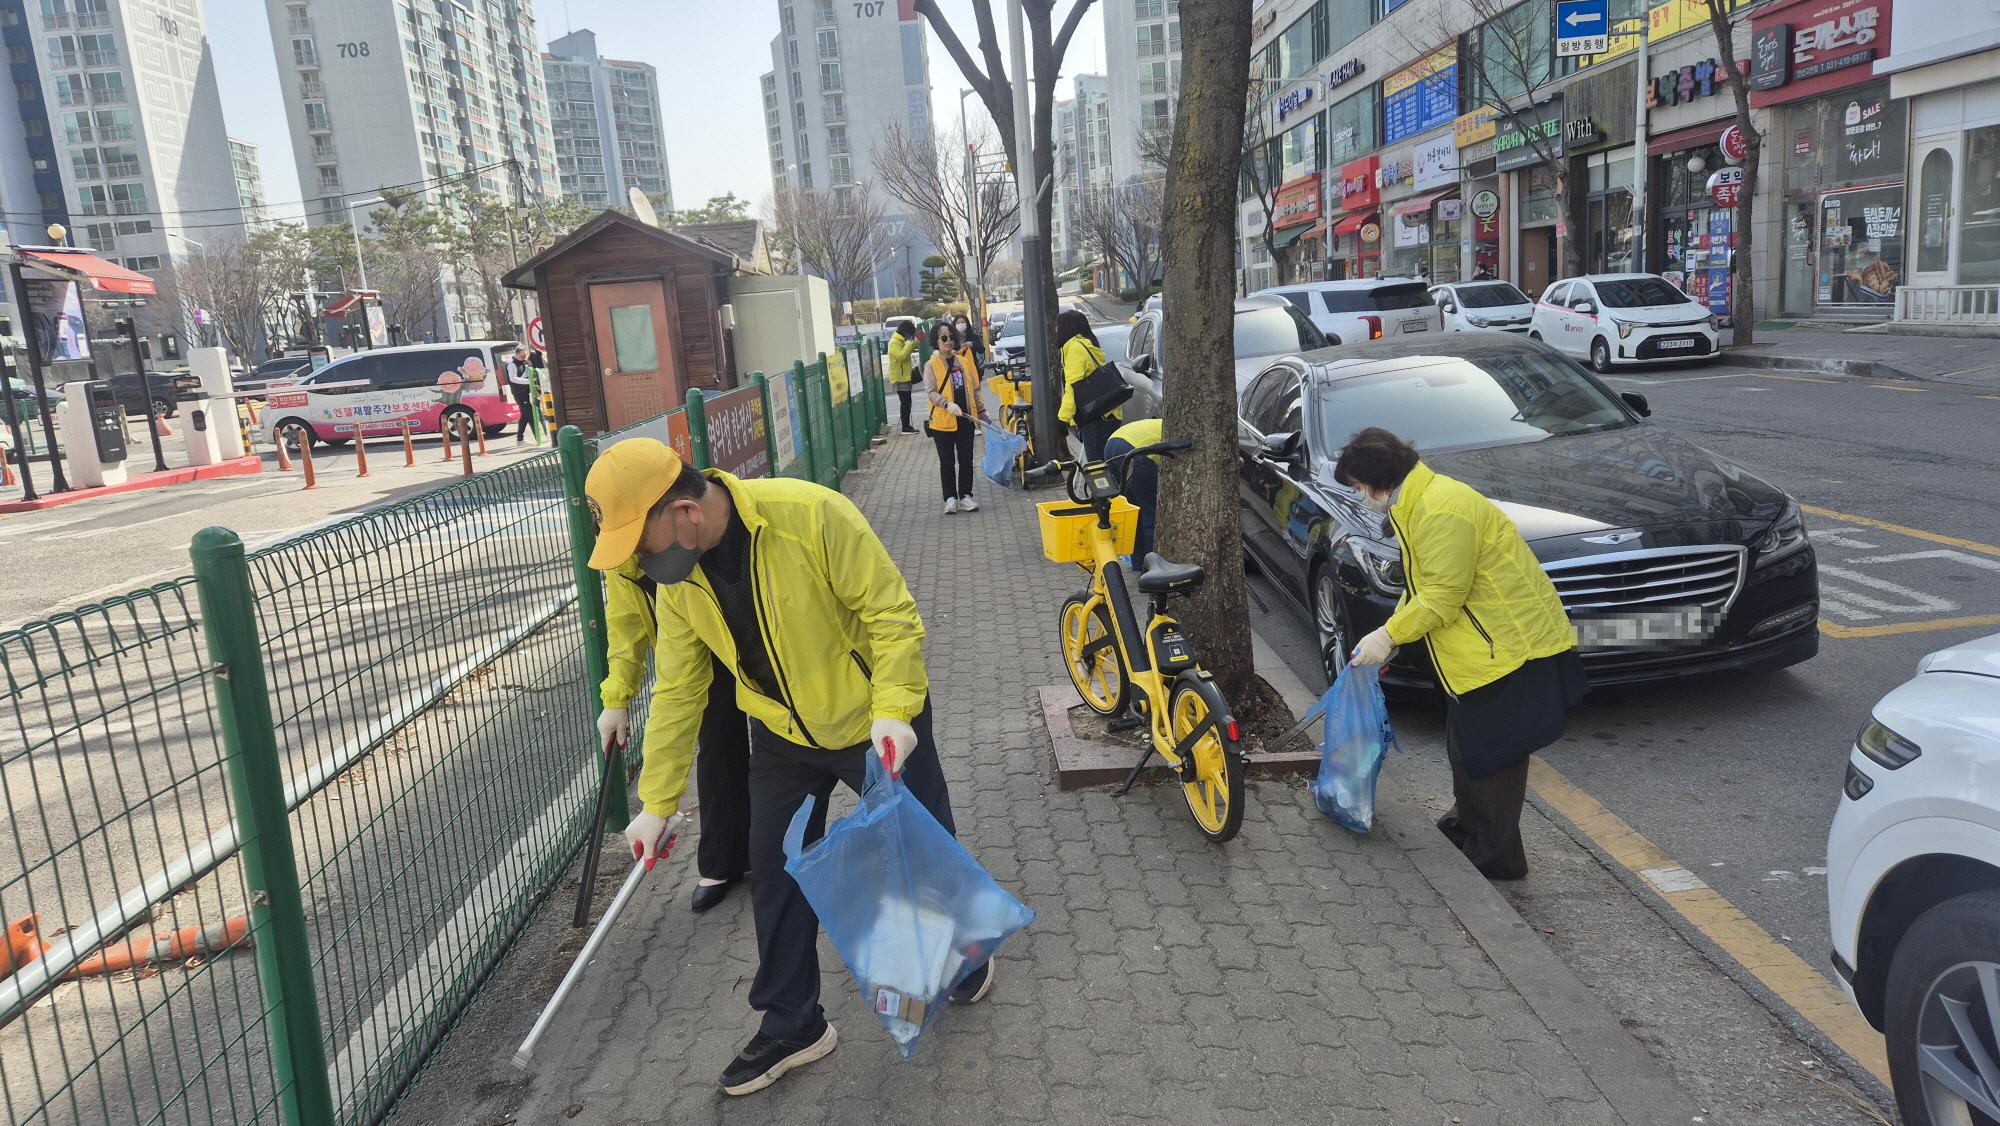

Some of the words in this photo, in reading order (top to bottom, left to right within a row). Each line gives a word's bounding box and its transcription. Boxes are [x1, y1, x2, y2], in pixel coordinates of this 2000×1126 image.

[853, 1, 885, 18] 707
[1648, 6, 1670, 30] 일가
[156, 14, 180, 37] 709
[1793, 6, 1880, 63] 돈까스짱
[336, 41, 370, 59] 708
[1560, 38, 1604, 53] 일방통행
[1646, 58, 1717, 108] 보약족발
[1862, 103, 1881, 119] SALE
[1566, 116, 1592, 141] With
[1849, 140, 1881, 165] 싸다!
[1863, 206, 1900, 222] 등심돈까스
[1866, 223, 1897, 238] 4장만원
[1570, 325, 1584, 333] service
[332, 400, 431, 418] 엔젤재활주간보호센터
[732, 400, 754, 450] 한정식
